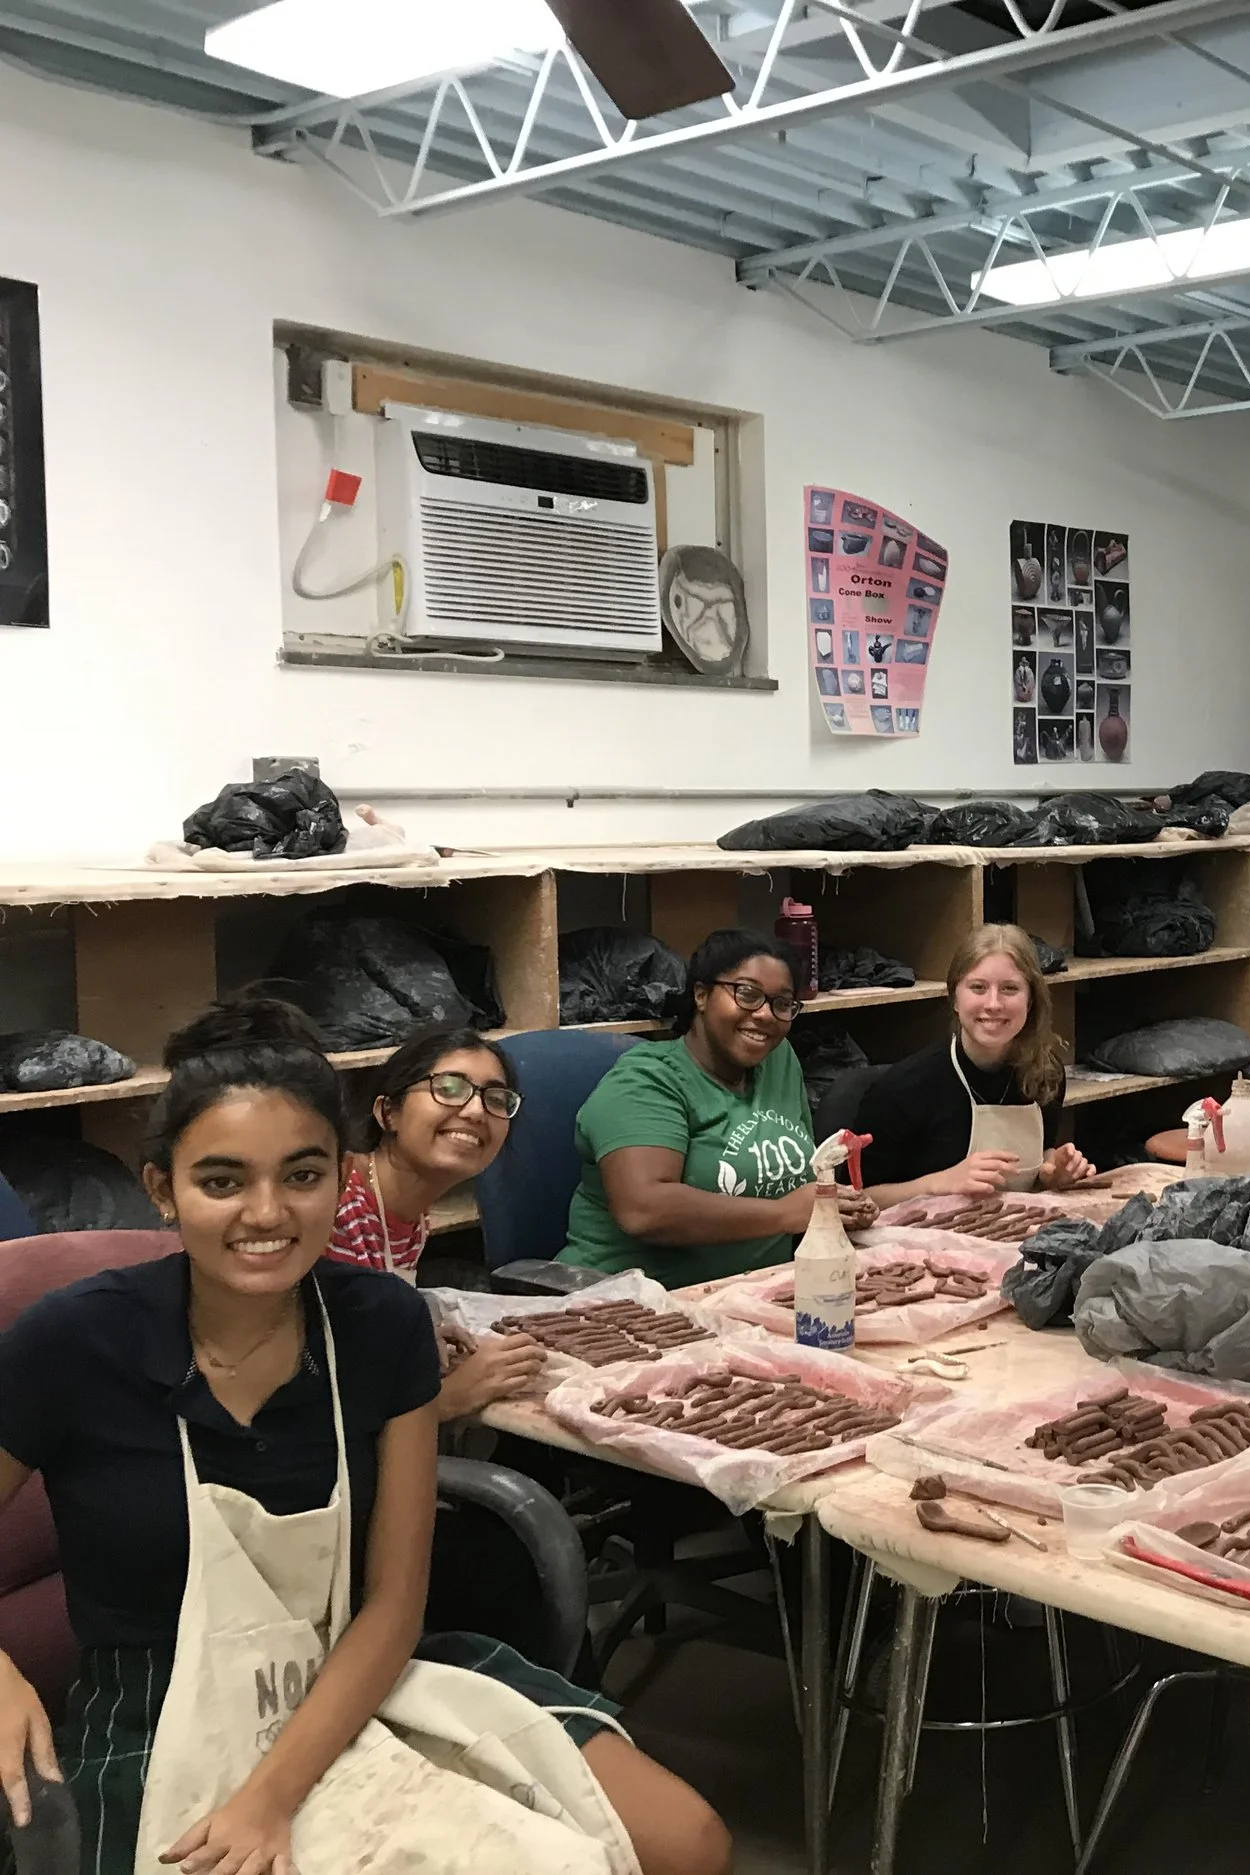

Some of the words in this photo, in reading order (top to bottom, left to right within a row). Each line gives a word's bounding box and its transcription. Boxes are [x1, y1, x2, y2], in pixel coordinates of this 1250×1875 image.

[850, 574, 893, 588] Orton
[838, 587, 862, 597] Cone
[864, 589, 886, 600] Box
[864, 615, 893, 625] Show
[722, 1130, 745, 1157] THE
[747, 1135, 806, 1184] 100
[754, 1173, 808, 1198] YEARS
